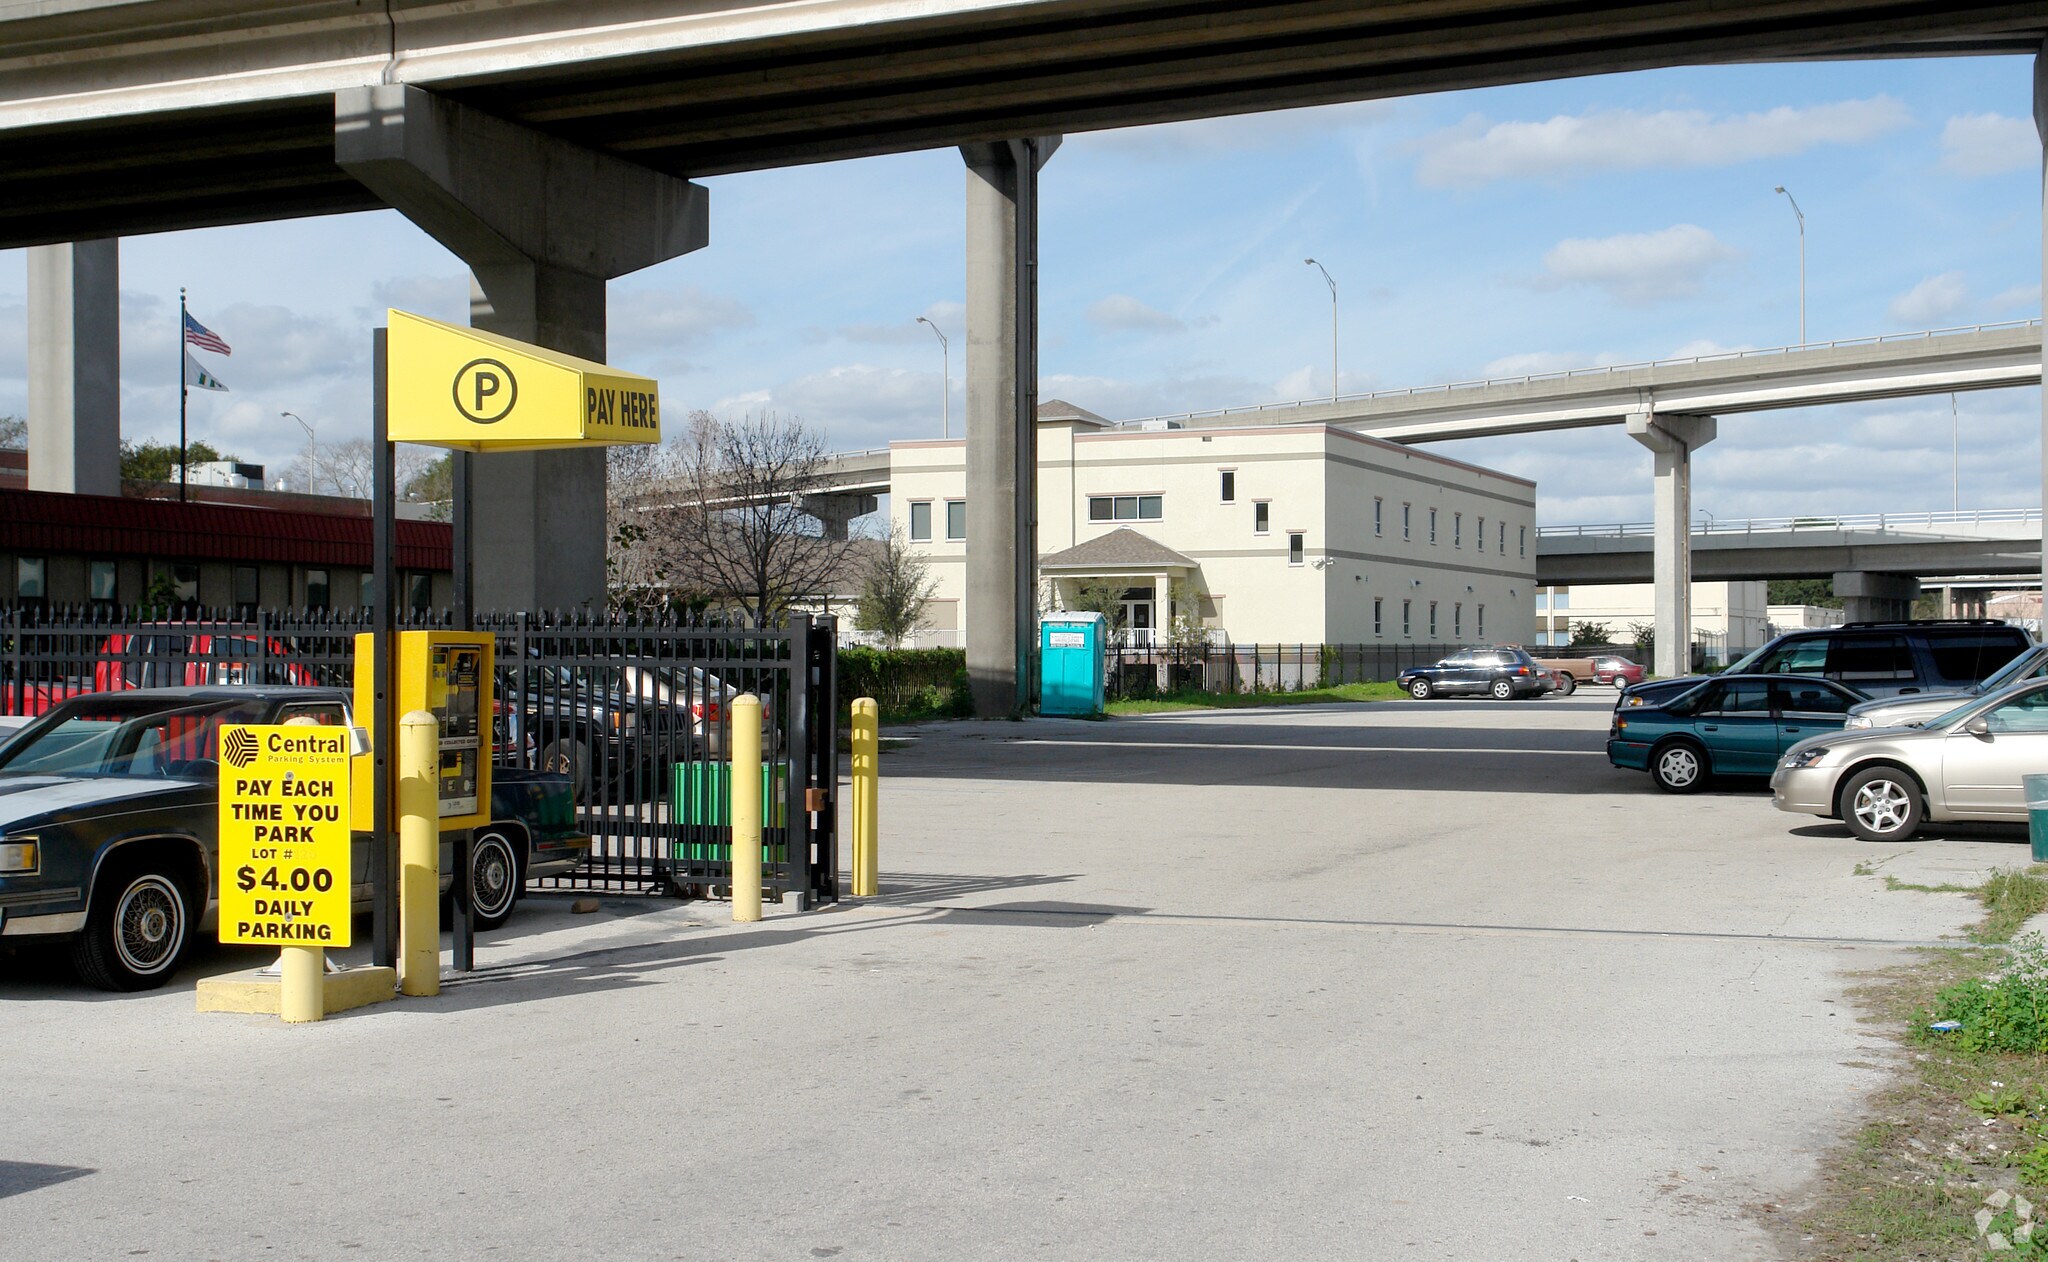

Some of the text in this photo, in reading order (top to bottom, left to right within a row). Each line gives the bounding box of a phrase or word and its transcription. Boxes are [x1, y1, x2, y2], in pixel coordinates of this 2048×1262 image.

[475, 371, 500, 411] P
[587, 387, 657, 429] PAY HERE
[267, 733, 345, 754] Central
[267, 755, 345, 764] Parking System
[236, 780, 333, 797] PAY EACH
[231, 804, 339, 822] TIME YOU
[254, 826, 315, 842] PARK
[252, 849, 278, 859] LOT
[237, 864, 333, 893] $4.00
[255, 900, 314, 916] DAILY
[238, 922, 331, 940] PARKING
